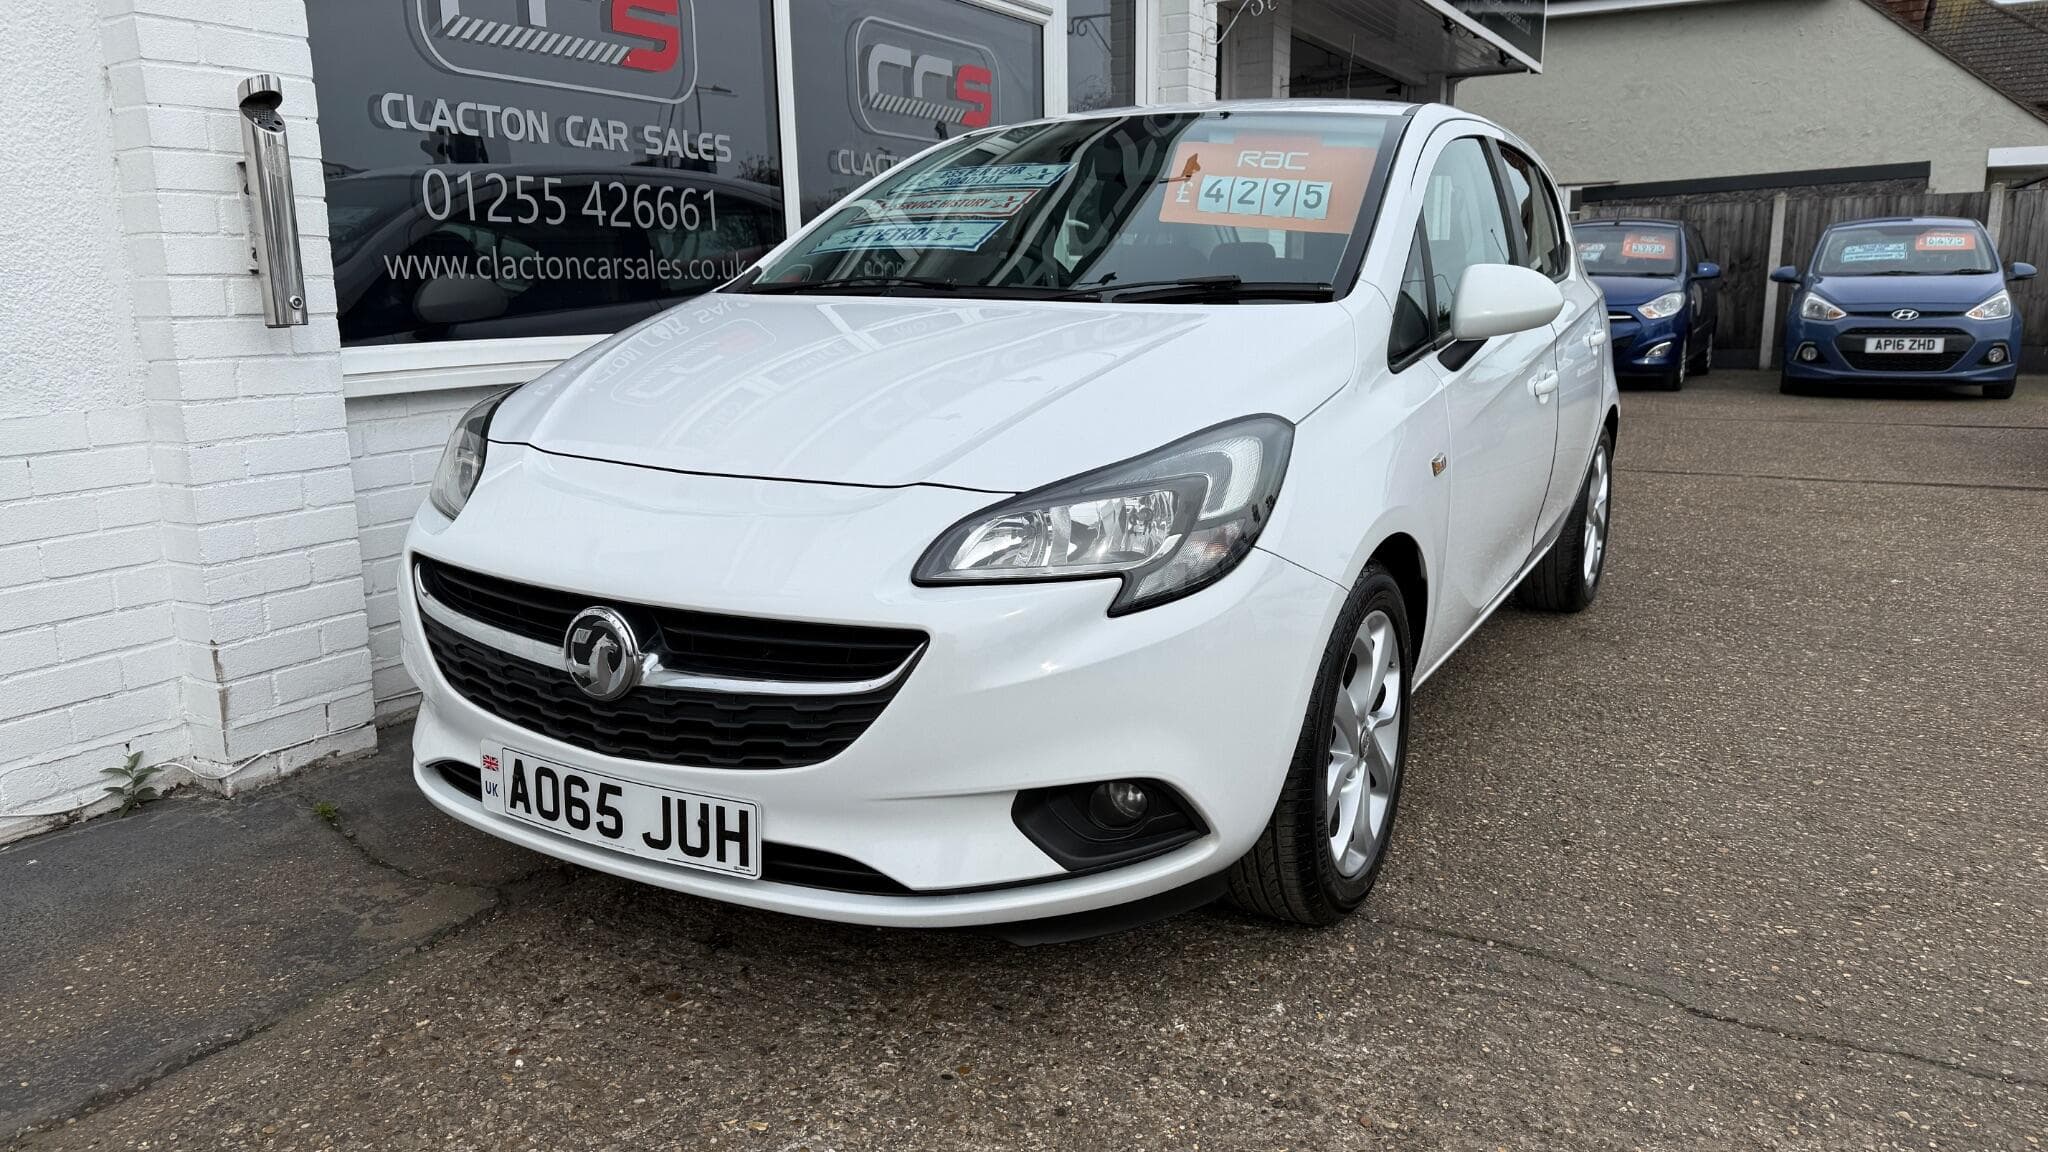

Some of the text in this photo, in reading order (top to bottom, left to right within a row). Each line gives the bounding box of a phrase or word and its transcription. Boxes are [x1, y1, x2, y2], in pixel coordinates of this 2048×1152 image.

[868, 43, 992, 128] CCS
[380, 92, 732, 163] CLACTON CAR SALES
[837, 149, 905, 177] CLACT
[422, 168, 717, 232] 01255 426661
[938, 198, 992, 208] HISTORY
[866, 226, 935, 242] PETROL
[383, 246, 748, 281] www.clactoncarsales.co.uk
[1875, 340, 1935, 350] AP16 ZHD
[485, 780, 498, 797] UK
[509, 759, 749, 866] AO65 JUH
